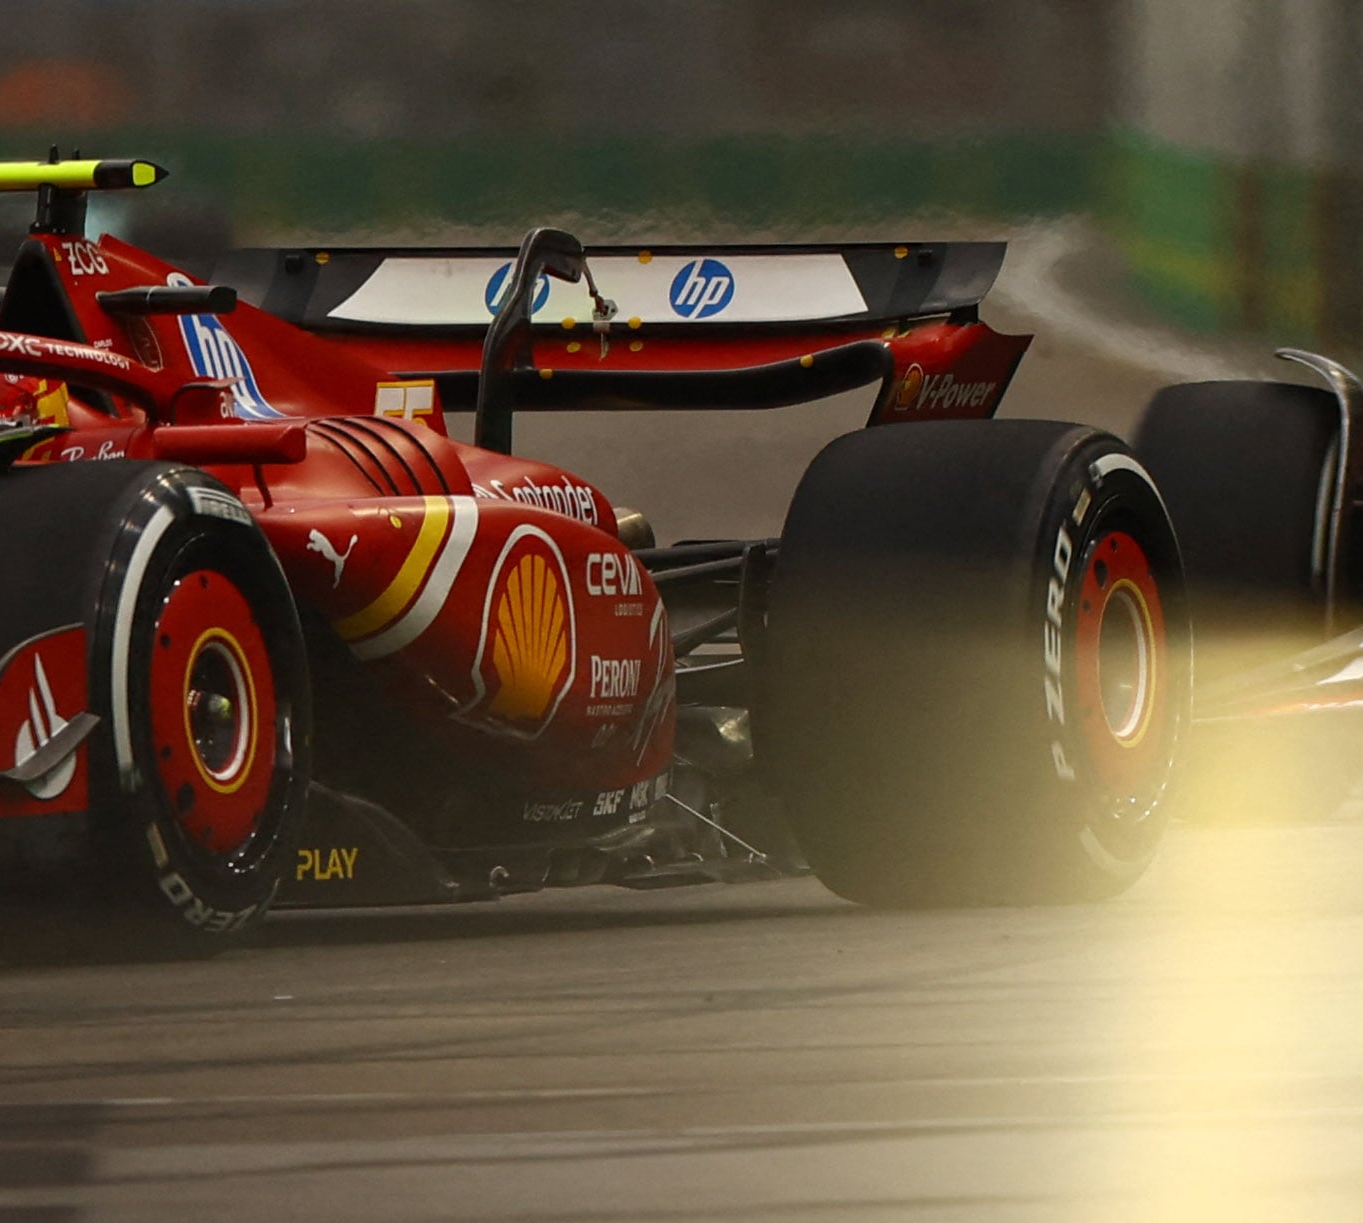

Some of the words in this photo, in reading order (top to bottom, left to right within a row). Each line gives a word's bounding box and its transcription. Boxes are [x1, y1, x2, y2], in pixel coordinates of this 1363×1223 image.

[672, 258, 731, 319] hp
[44, 342, 131, 371] TECHNOLOGY
[917, 374, 997, 410] V-Power
[297, 848, 358, 880] PLAY
